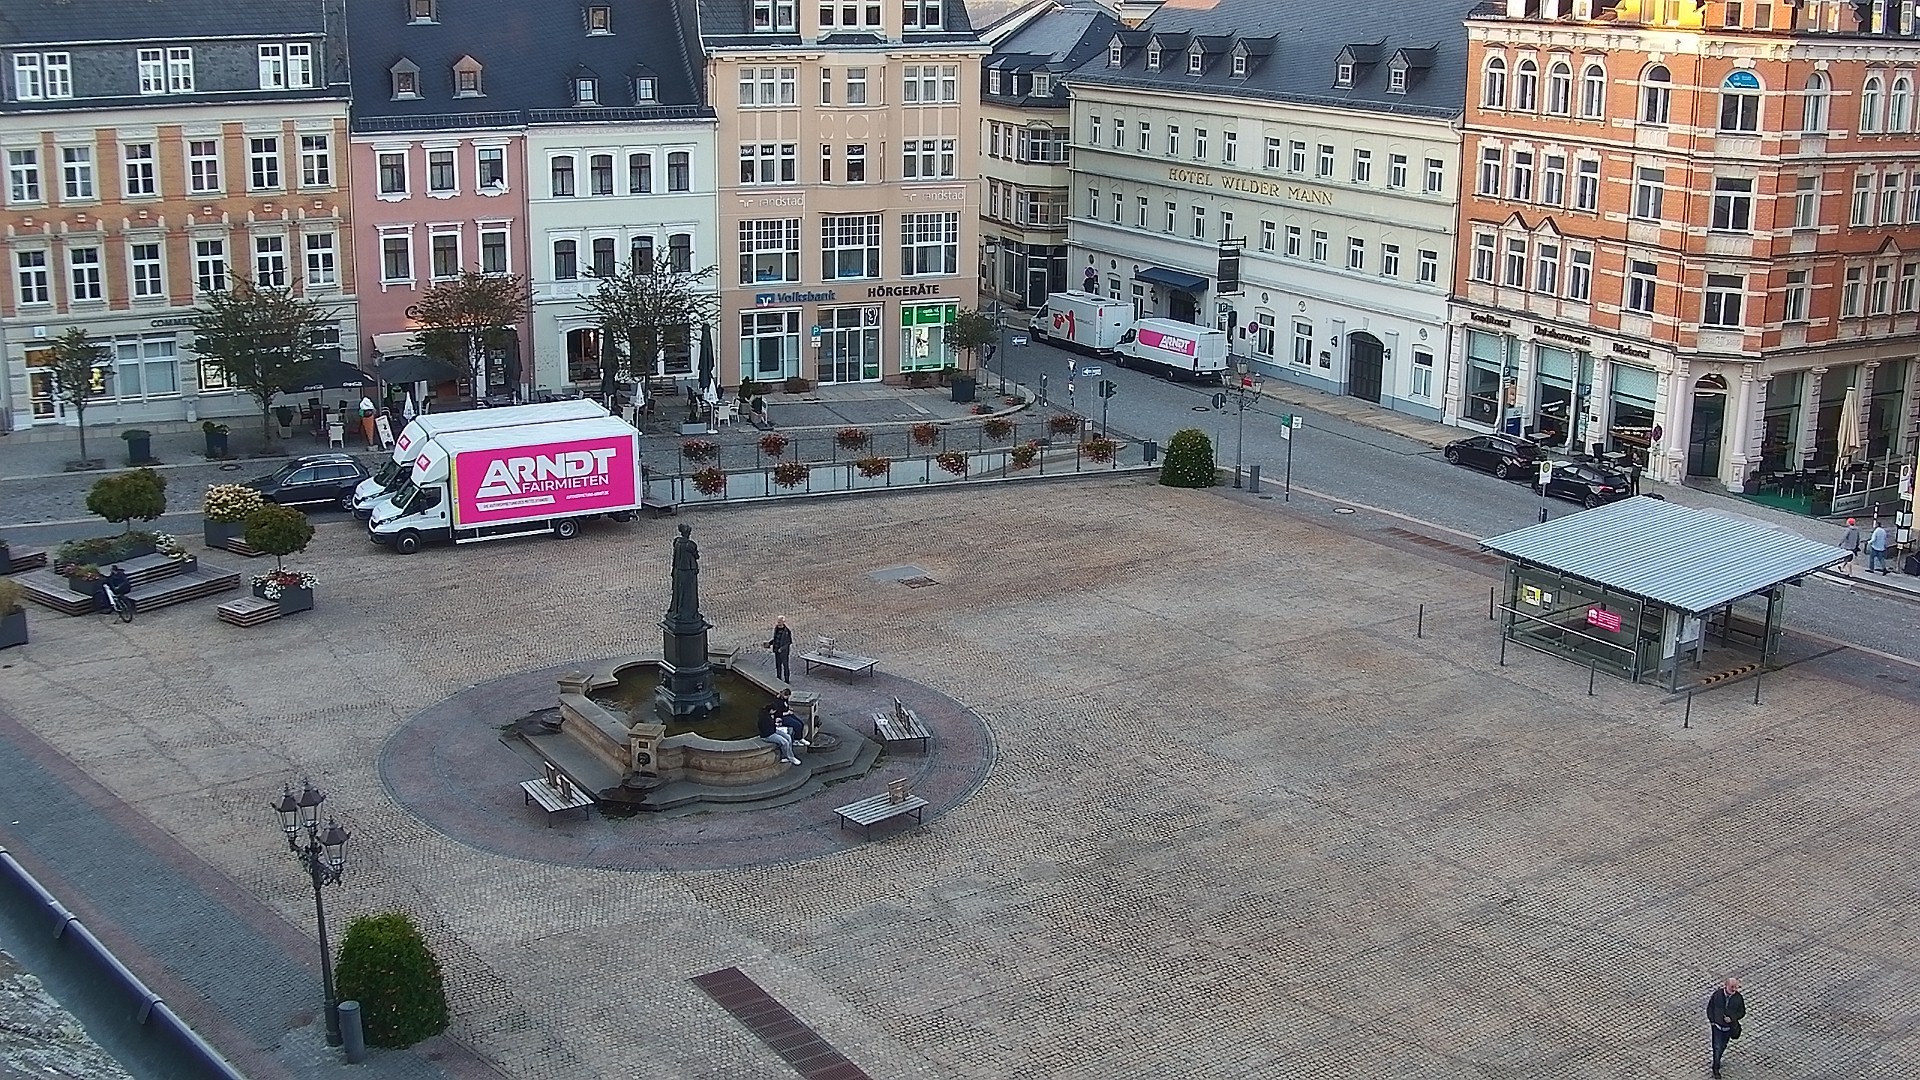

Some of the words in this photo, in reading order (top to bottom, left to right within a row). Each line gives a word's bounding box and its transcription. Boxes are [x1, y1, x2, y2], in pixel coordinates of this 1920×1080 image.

[1168, 167, 1213, 187] HOTEL
[1221, 175, 1280, 198] WILDER
[1287, 186, 1334, 206] MANN
[777, 289, 836, 303] Volksbank
[867, 282, 940, 298] HÖRGERÄTE
[1159, 334, 1191, 351] ARNDT
[475, 447, 617, 499] ARNDT
[522, 475, 609, 494] FAIRMIETEN
